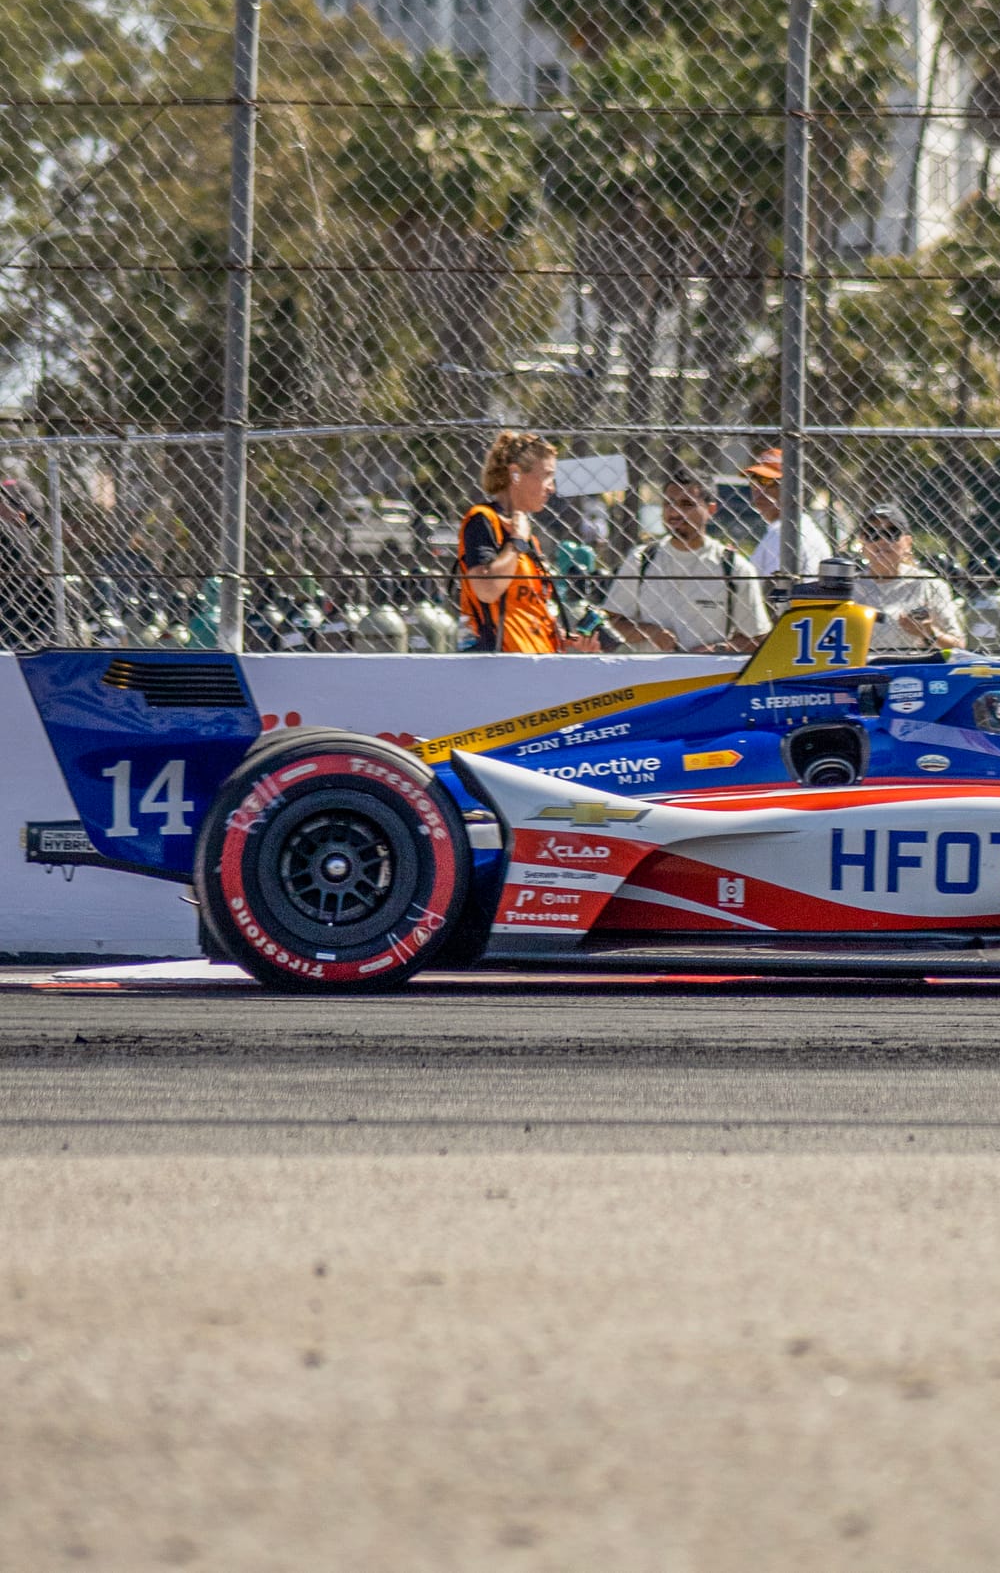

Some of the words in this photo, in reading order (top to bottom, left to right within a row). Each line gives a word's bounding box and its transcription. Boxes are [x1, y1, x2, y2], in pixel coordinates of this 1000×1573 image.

[791, 618, 850, 665] 14
[428, 730, 482, 755] SPIRIT:
[486, 723, 515, 739] 250
[518, 707, 570, 730] YEARS
[573, 688, 635, 714] STRONG
[516, 738, 560, 757] JON
[564, 723, 632, 747] HART
[102, 760, 194, 837] 14
[348, 758, 447, 841] Firestone
[618, 772, 655, 785] MJN
[231, 896, 325, 978] Firestone
[505, 910, 579, 925] Firestone
